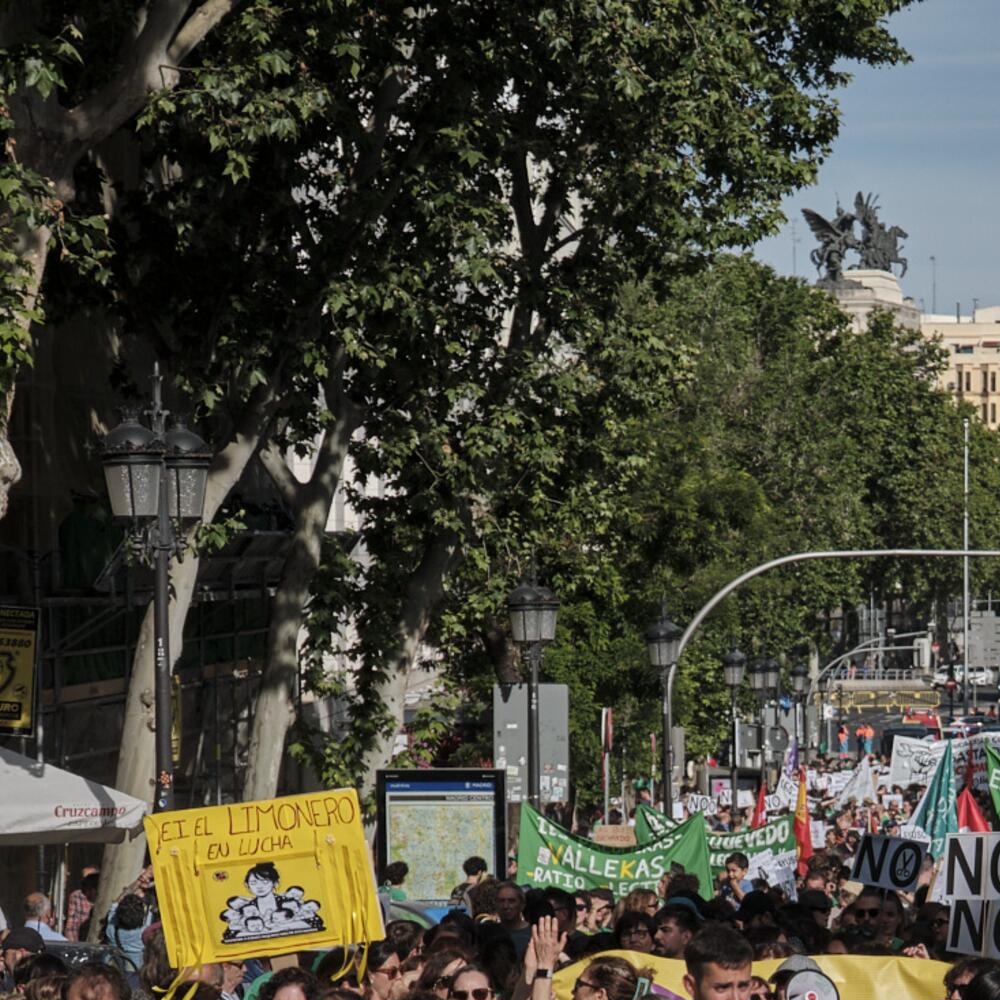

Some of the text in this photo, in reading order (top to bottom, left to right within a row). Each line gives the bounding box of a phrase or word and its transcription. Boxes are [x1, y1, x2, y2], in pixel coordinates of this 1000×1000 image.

[194, 816, 213, 837] EL
[227, 796, 355, 836] LIMONERO
[207, 834, 293, 861] EN LUCHA
[549, 843, 666, 880] VALLEKAS
[853, 834, 922, 889] NO
